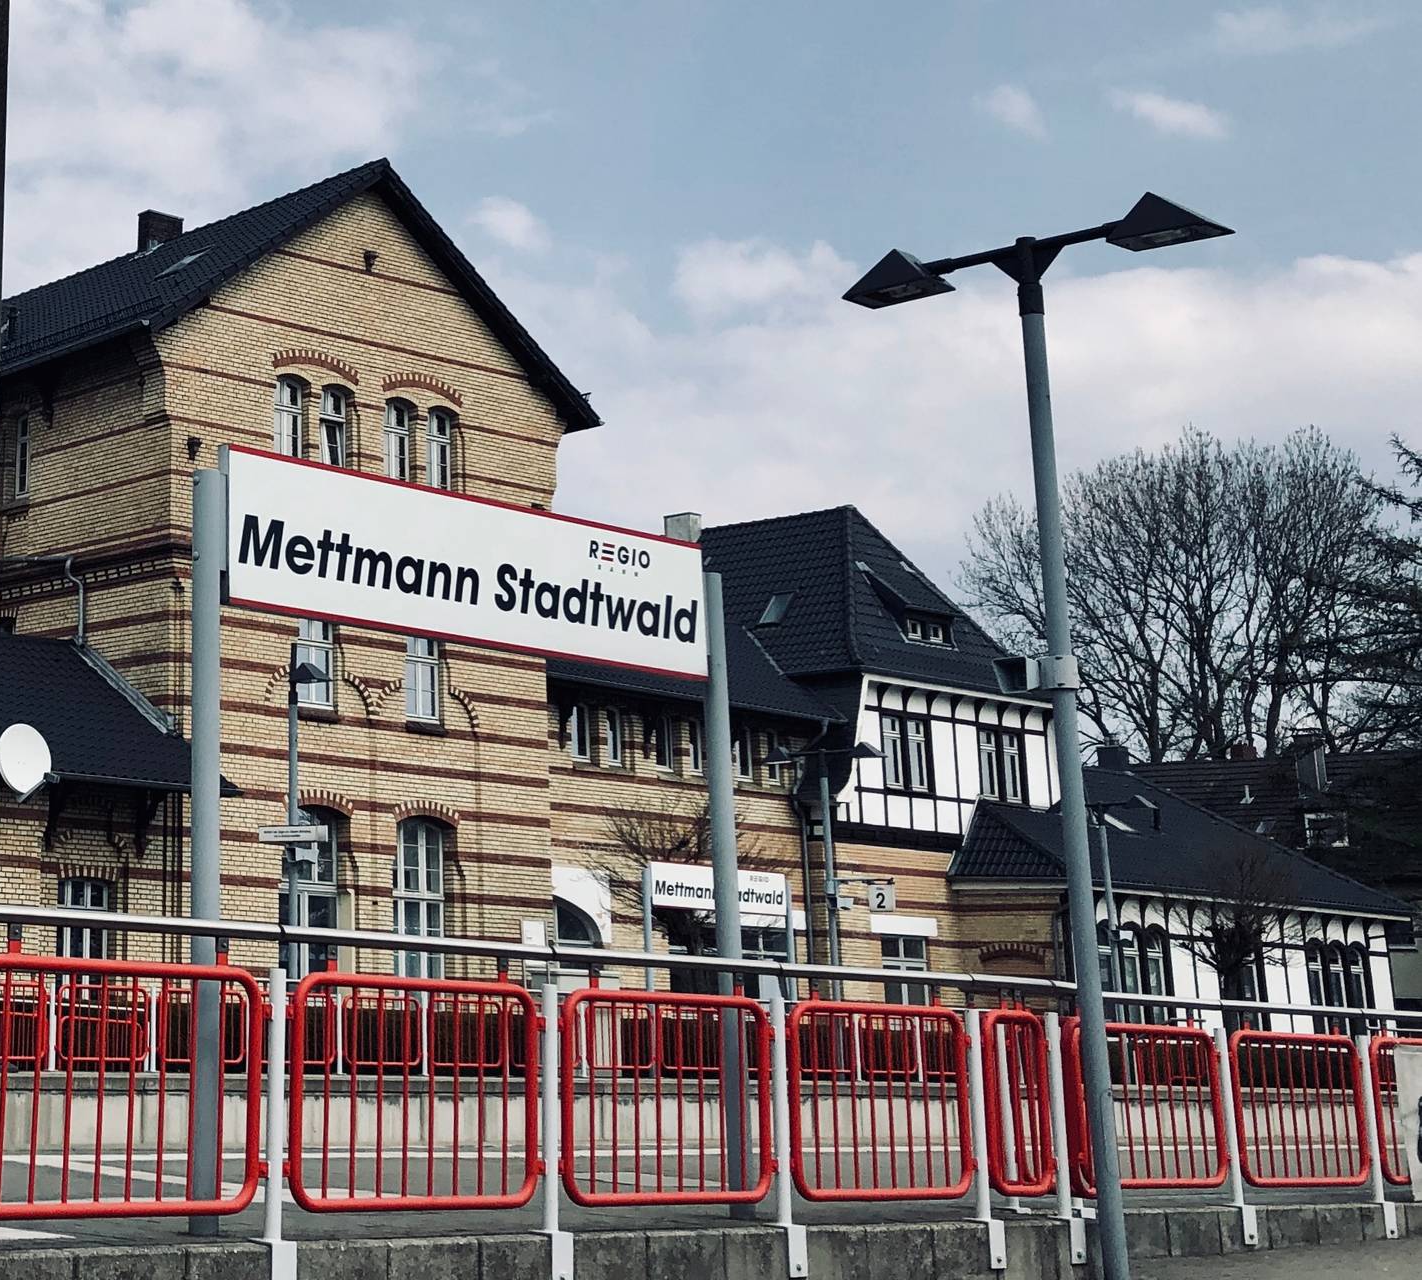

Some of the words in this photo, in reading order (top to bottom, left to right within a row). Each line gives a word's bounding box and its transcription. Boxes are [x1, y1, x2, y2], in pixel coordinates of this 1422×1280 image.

[589, 540, 650, 569] REGIO
[238, 513, 480, 606] Mettmann
[494, 563, 698, 644] Stadtwald
[654, 879, 715, 900] Mettman
[738, 888, 784, 905] dtwald
[876, 892, 886, 909] 2
